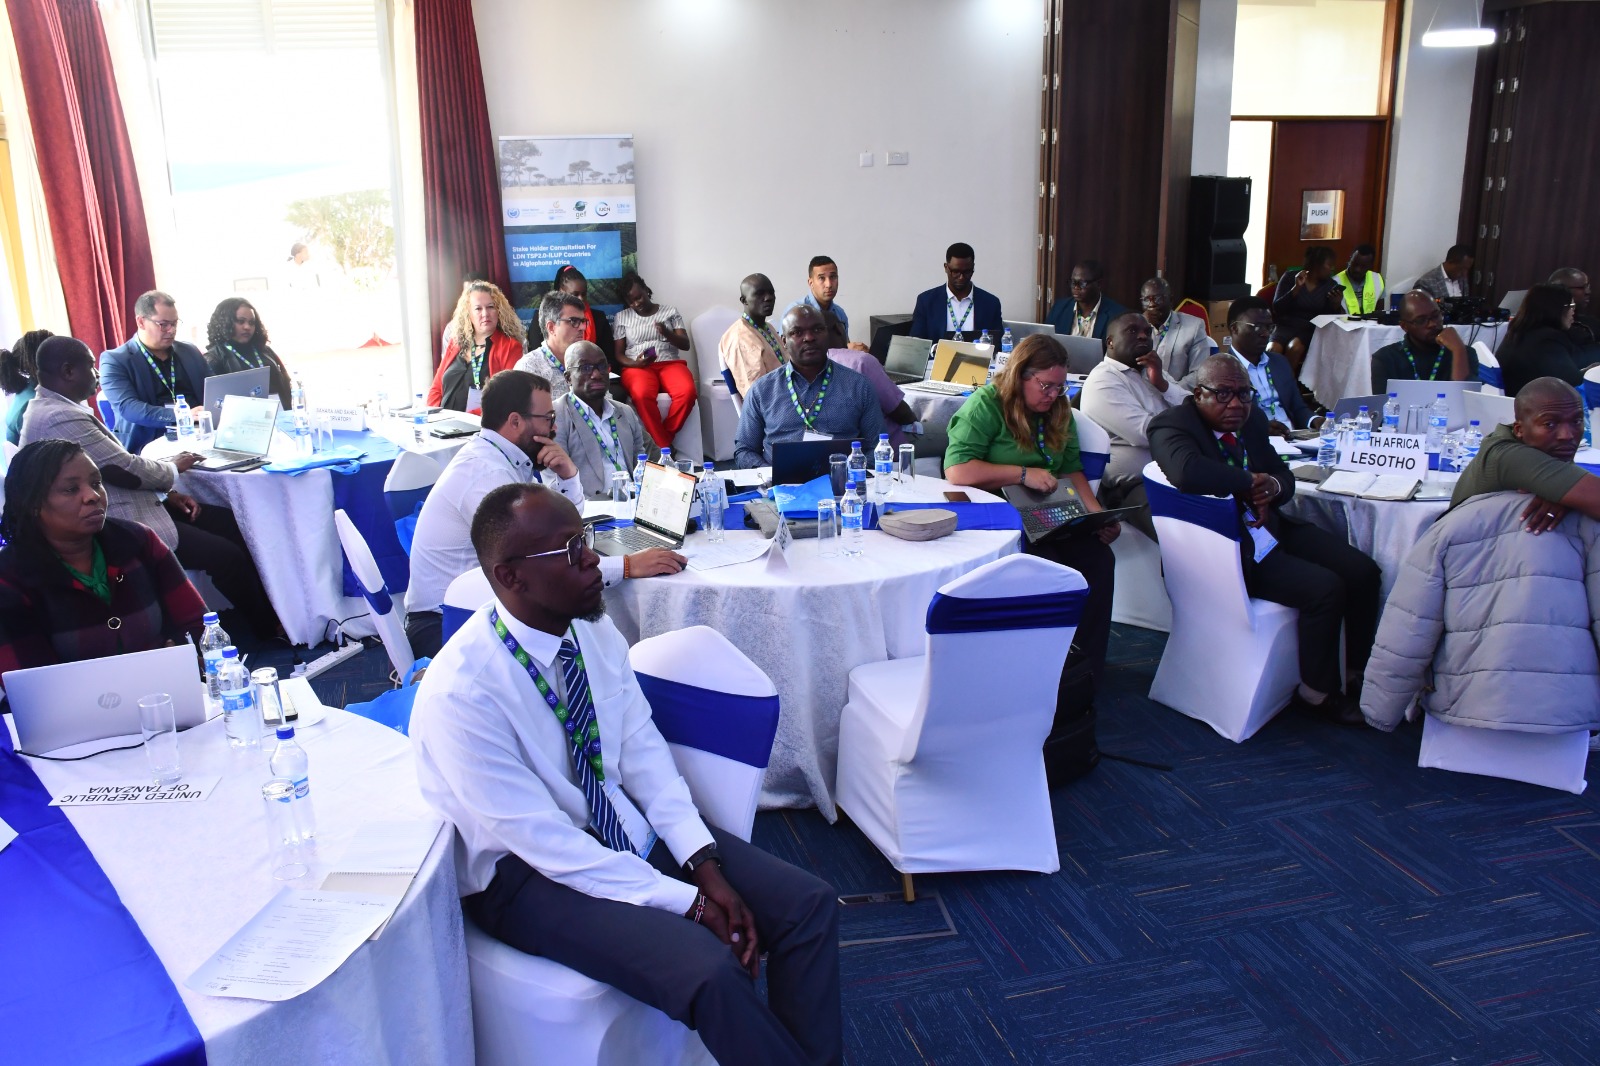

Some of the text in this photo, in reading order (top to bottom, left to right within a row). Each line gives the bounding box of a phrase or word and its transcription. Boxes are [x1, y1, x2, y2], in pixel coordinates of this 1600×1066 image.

[576, 211, 587, 219] gef
[1311, 209, 1329, 217] PUSH
[1383, 437, 1420, 450] AFRICA
[1350, 451, 1416, 470] LESOTHO
[88, 784, 190, 794] OF TANZANIA
[60, 790, 202, 803] UNITED REPUBLIC
